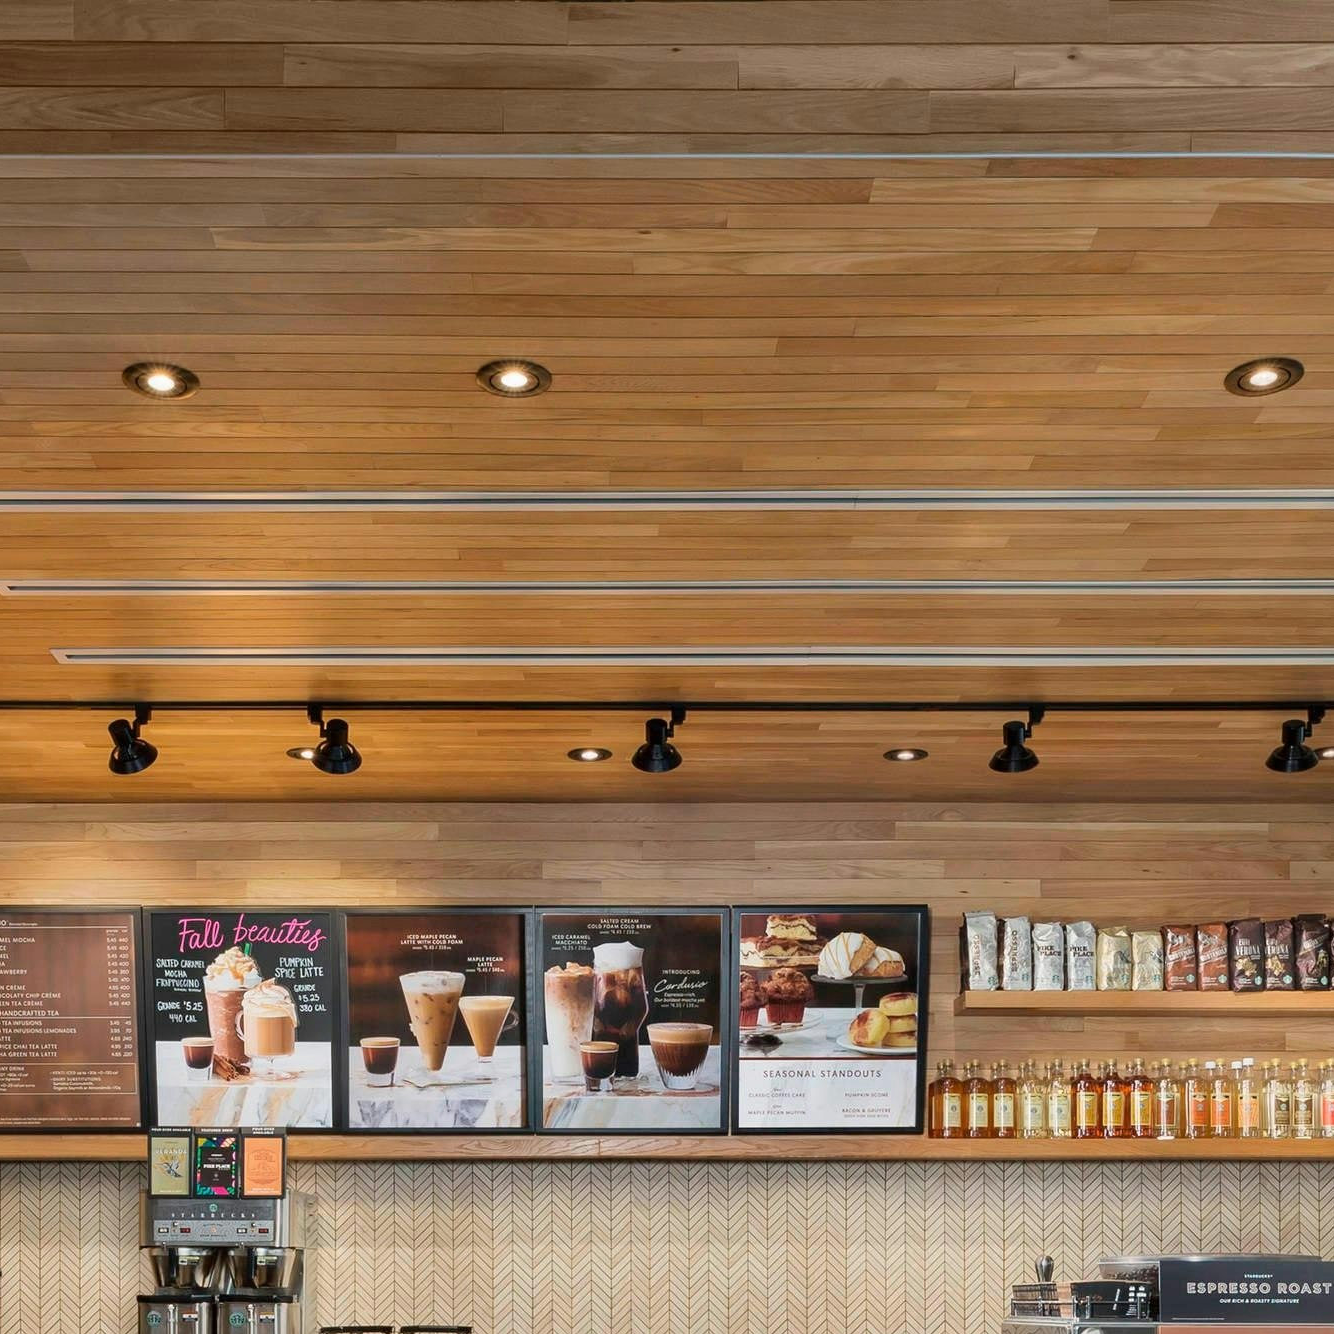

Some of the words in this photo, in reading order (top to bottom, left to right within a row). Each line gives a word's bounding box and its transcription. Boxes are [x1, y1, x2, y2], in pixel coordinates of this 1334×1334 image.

[178, 918, 225, 952] Fall
[233, 913, 327, 952] beauties
[156, 958, 179, 968] SALTED
[181, 960, 205, 969] CARAMEL
[279, 957, 314, 968] PUMPKIN
[165, 970, 187, 978] MOCHA
[275, 967, 295, 978] SPICE
[300, 967, 324, 978] LATTE
[156, 979, 200, 988] FRAPPUCCINO
[294, 984, 316, 992] GRANDE
[654, 977, 708, 993] Cordusio
[158, 1002, 180, 1011] GRANDE
[300, 1004, 313, 1012] 380
[169, 1014, 183, 1022] 440
[185, 1014, 197, 1022] CAL
[763, 1070, 815, 1078] SEASONAL
[820, 1070, 881, 1078] STANDOUTS
[1187, 1282, 1271, 1294] ESPRESSO
[1277, 1282, 1332, 1294] ROAST
